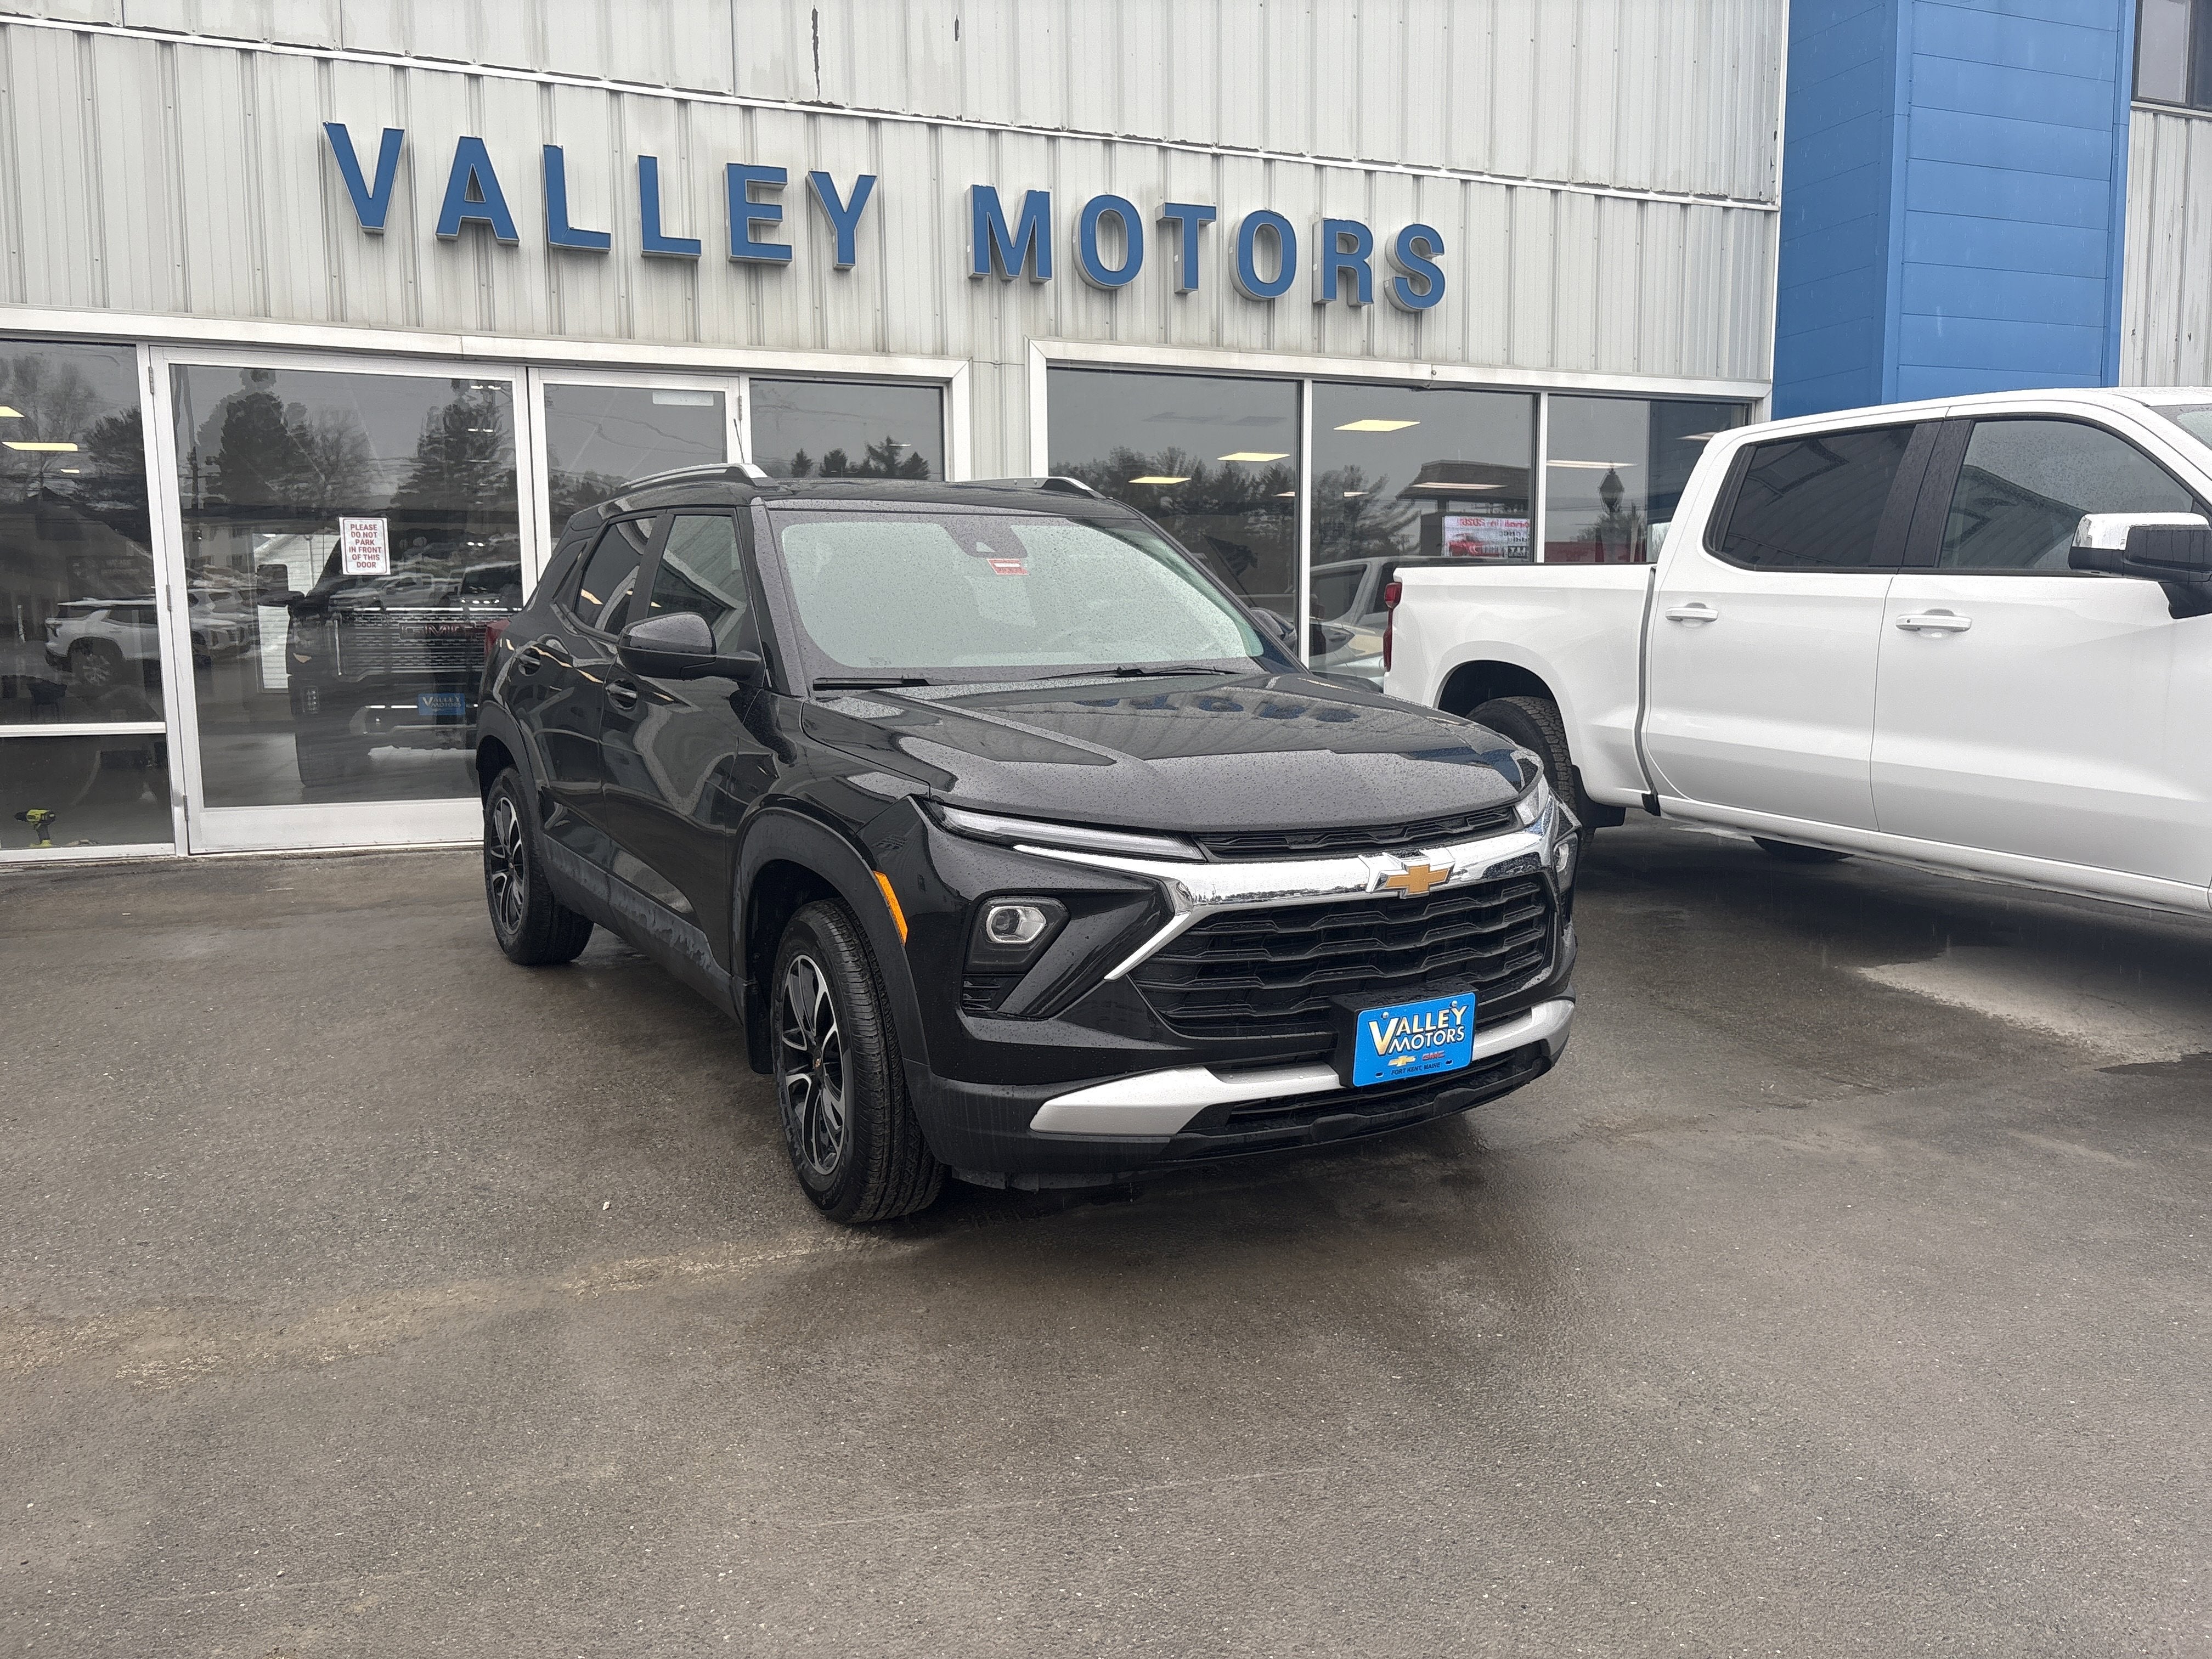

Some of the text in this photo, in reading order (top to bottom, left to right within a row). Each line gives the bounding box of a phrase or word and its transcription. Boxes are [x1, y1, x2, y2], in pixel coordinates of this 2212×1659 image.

[323, 120, 1446, 313] VALLEY MOTORS
[422, 695, 460, 706] VALLEY
[1368, 1005, 1469, 1056] VALLEY
[1388, 1025, 1465, 1054] MOTORS
[1422, 1050, 1446, 1061] GMC
[1391, 1068, 1406, 1076] FORT
[1423, 1062, 1441, 1070] MAINE
